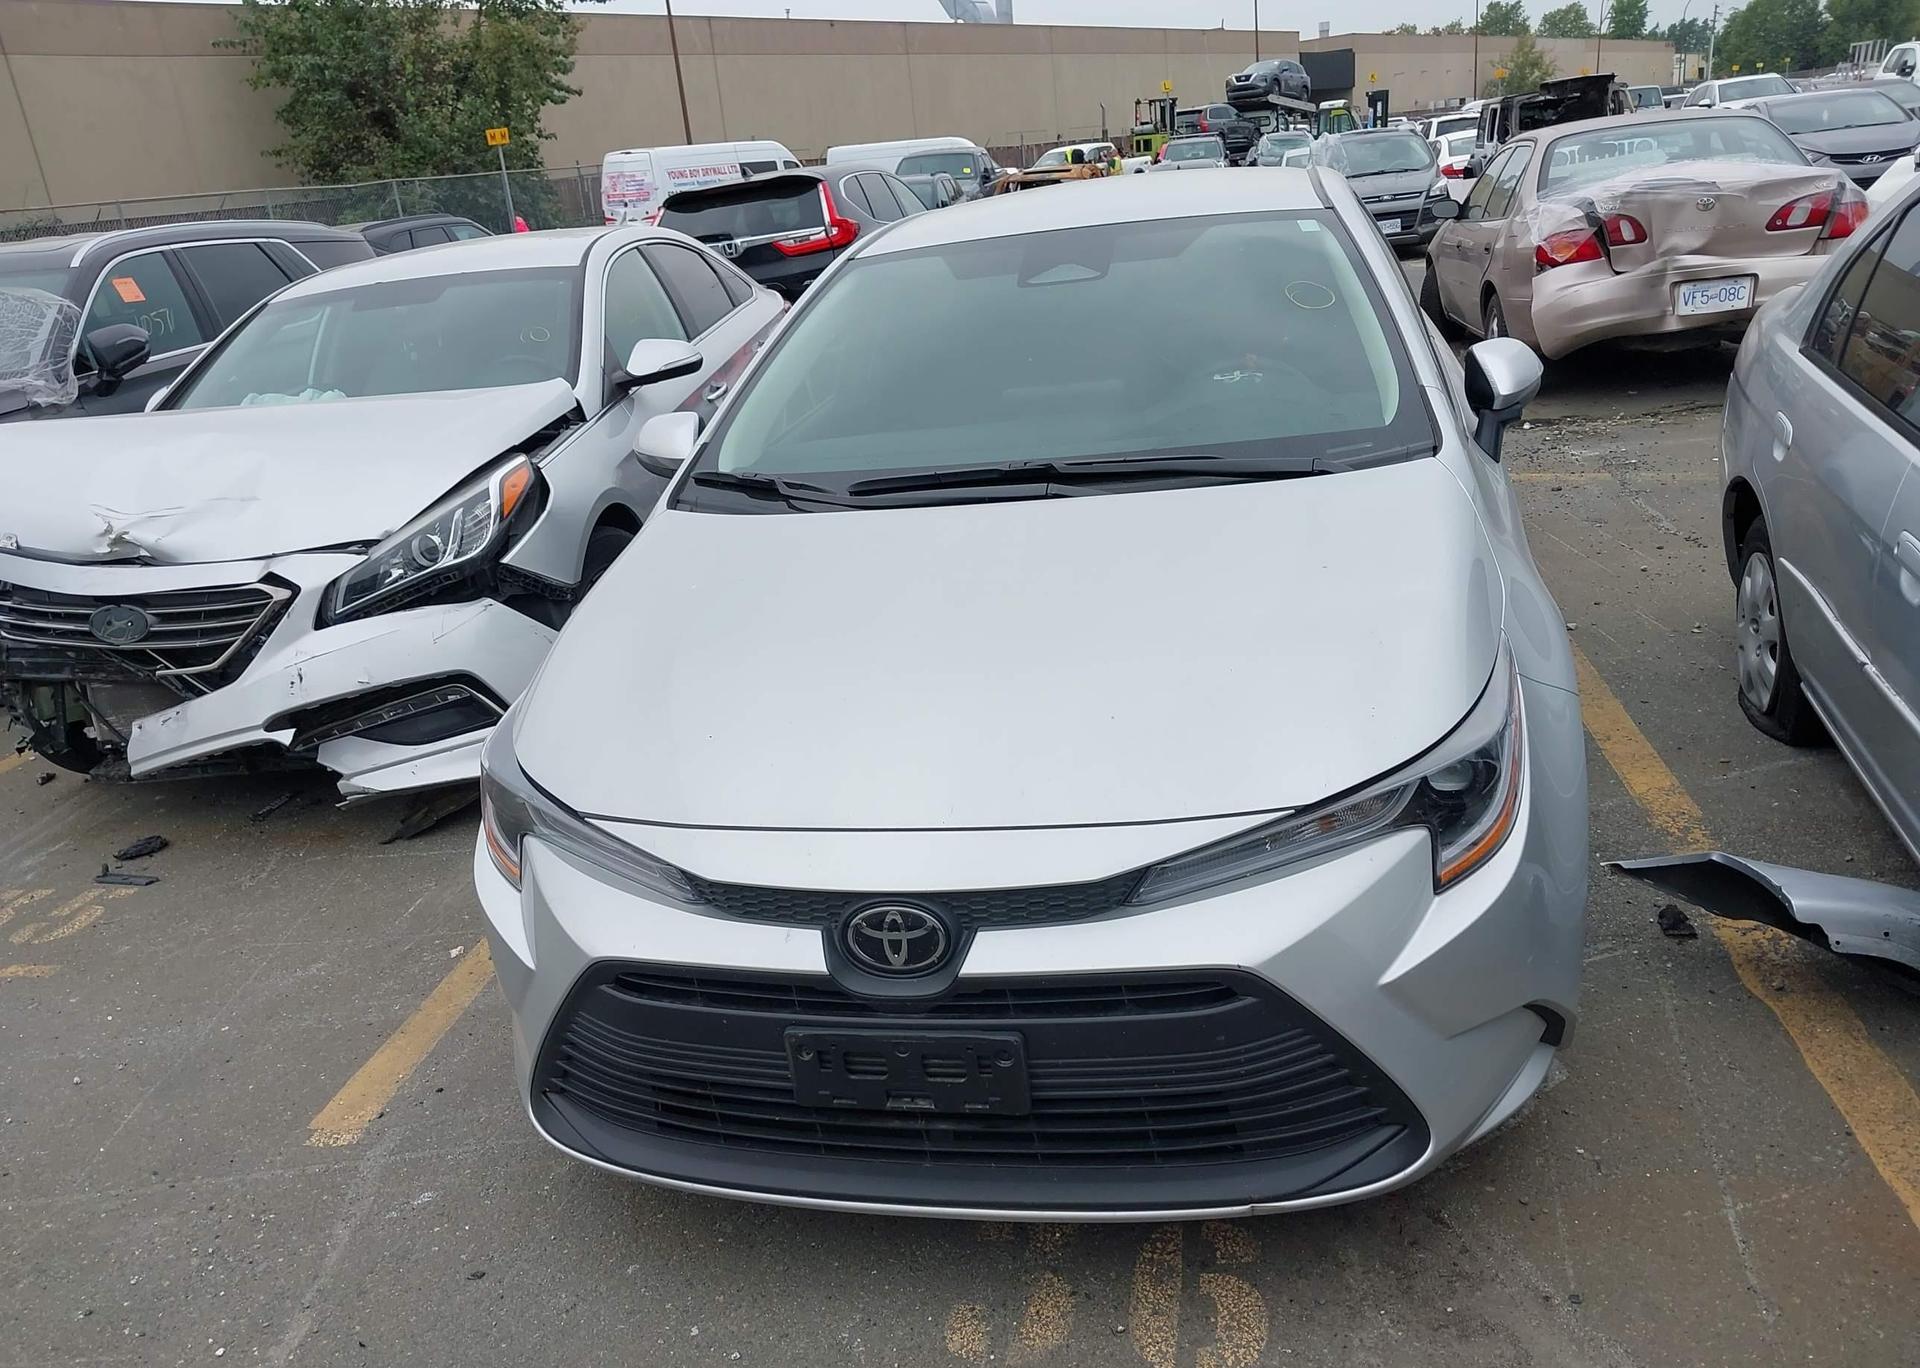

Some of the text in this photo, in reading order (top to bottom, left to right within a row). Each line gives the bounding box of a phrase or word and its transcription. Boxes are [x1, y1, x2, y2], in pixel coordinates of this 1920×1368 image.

[667, 170, 688, 181] YOUNG
[689, 168, 700, 179] BOY
[701, 165, 728, 177] DRYWALL
